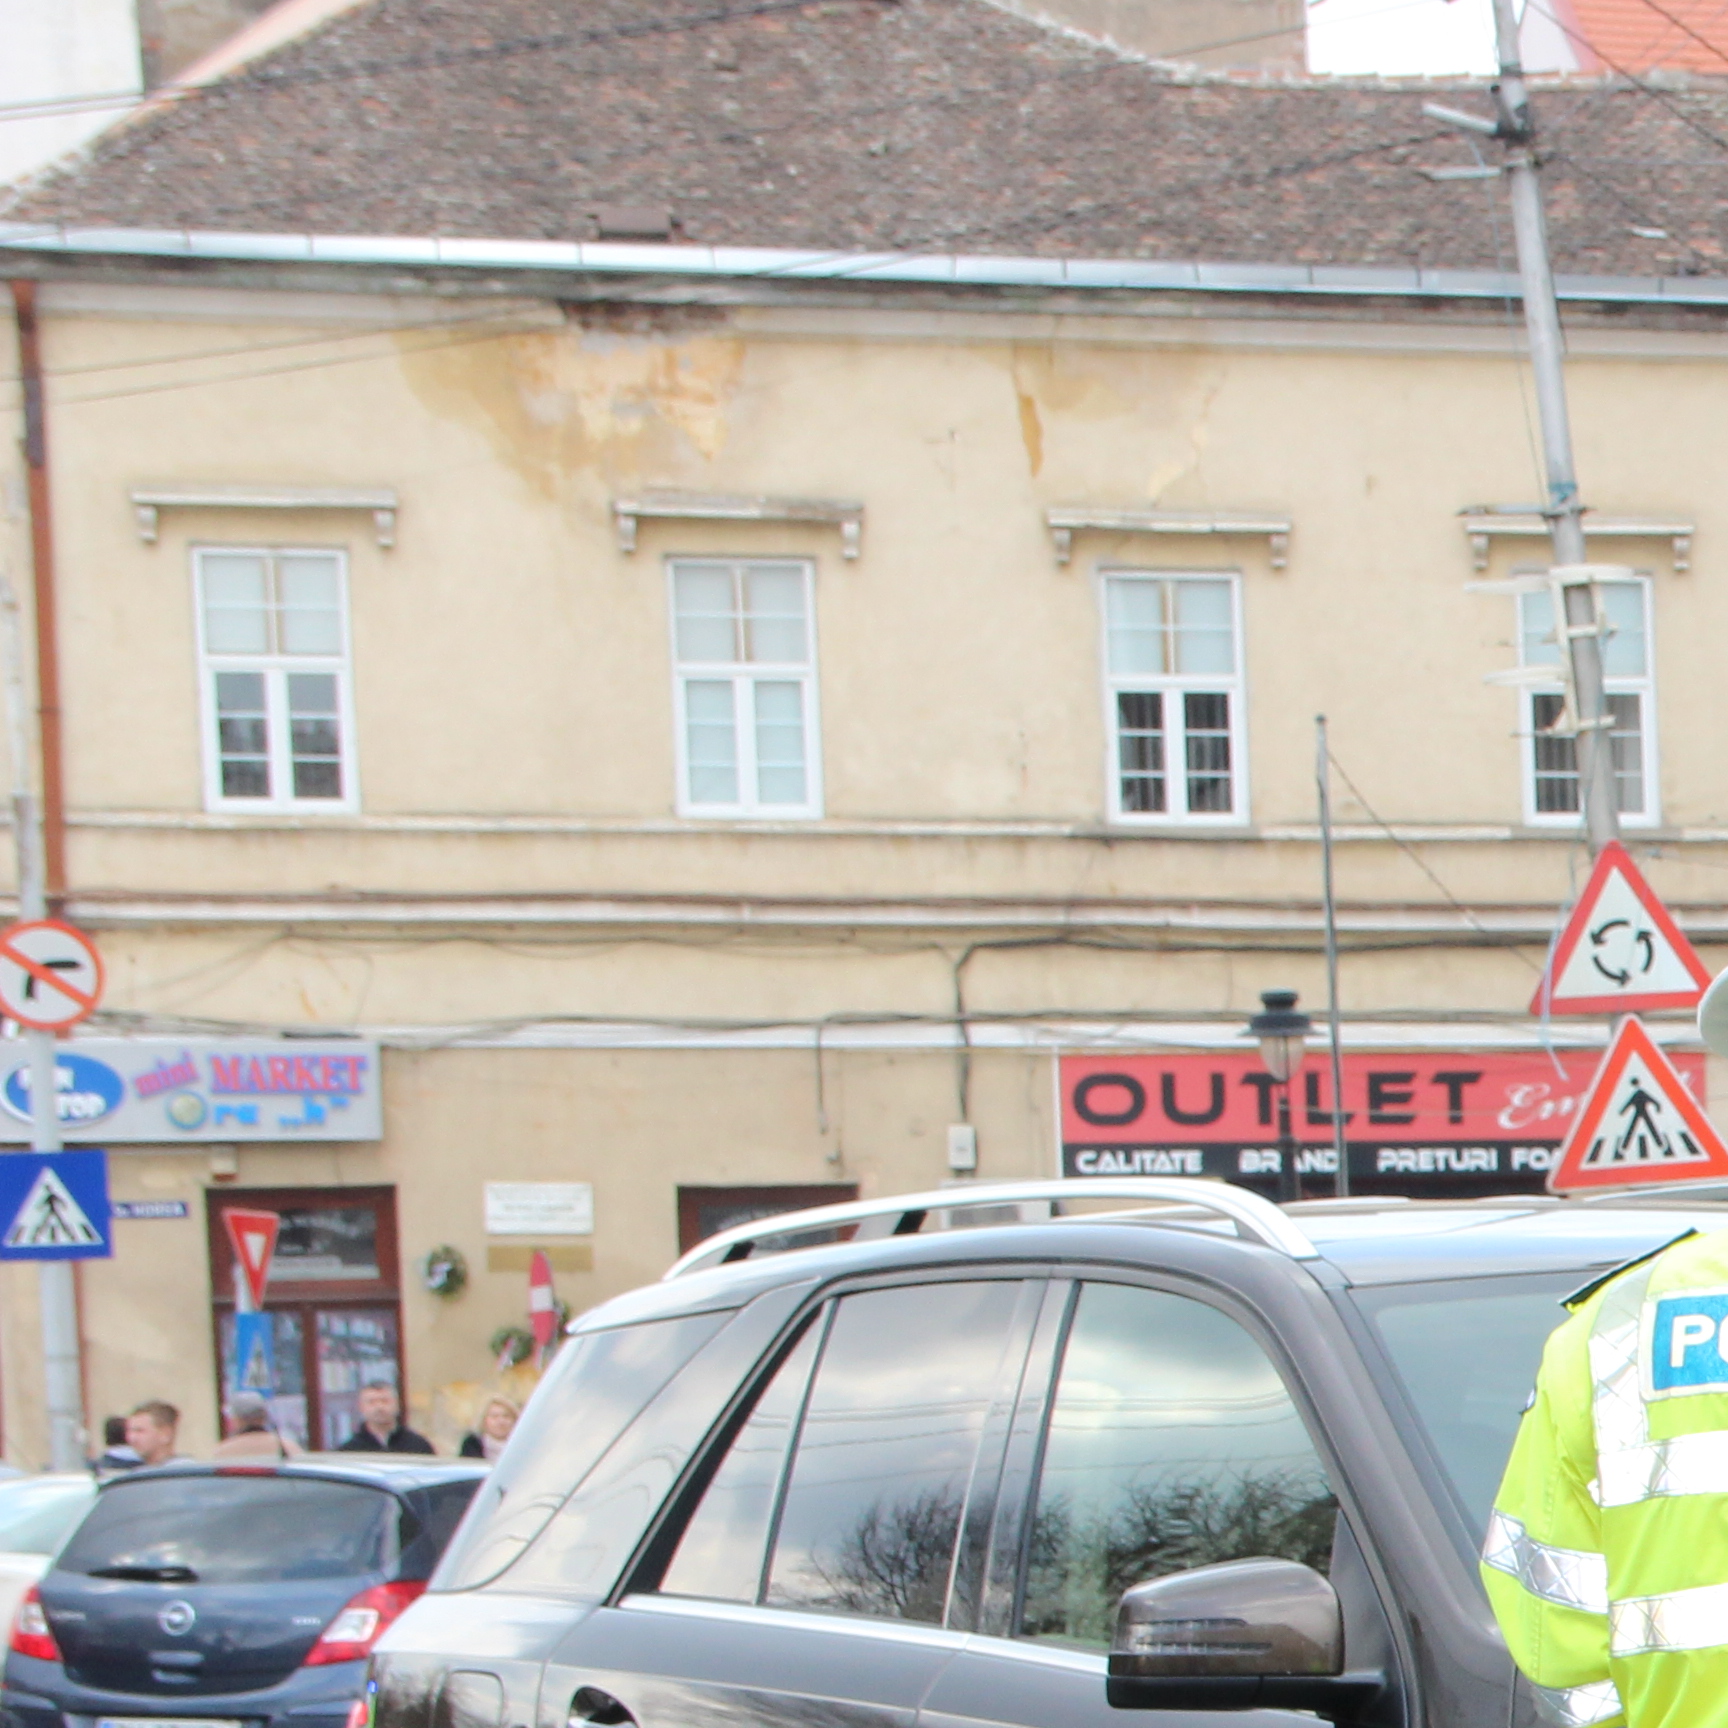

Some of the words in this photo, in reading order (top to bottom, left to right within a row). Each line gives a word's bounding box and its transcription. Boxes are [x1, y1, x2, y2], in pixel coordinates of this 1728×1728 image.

[133, 1049, 200, 1099] mini
[209, 1055, 369, 1095] MARKET
[1072, 1071, 1484, 1127] OUTLET
[1075, 1149, 1204, 1175] CALITATE
[1377, 1147, 1499, 1173] PRETURI
